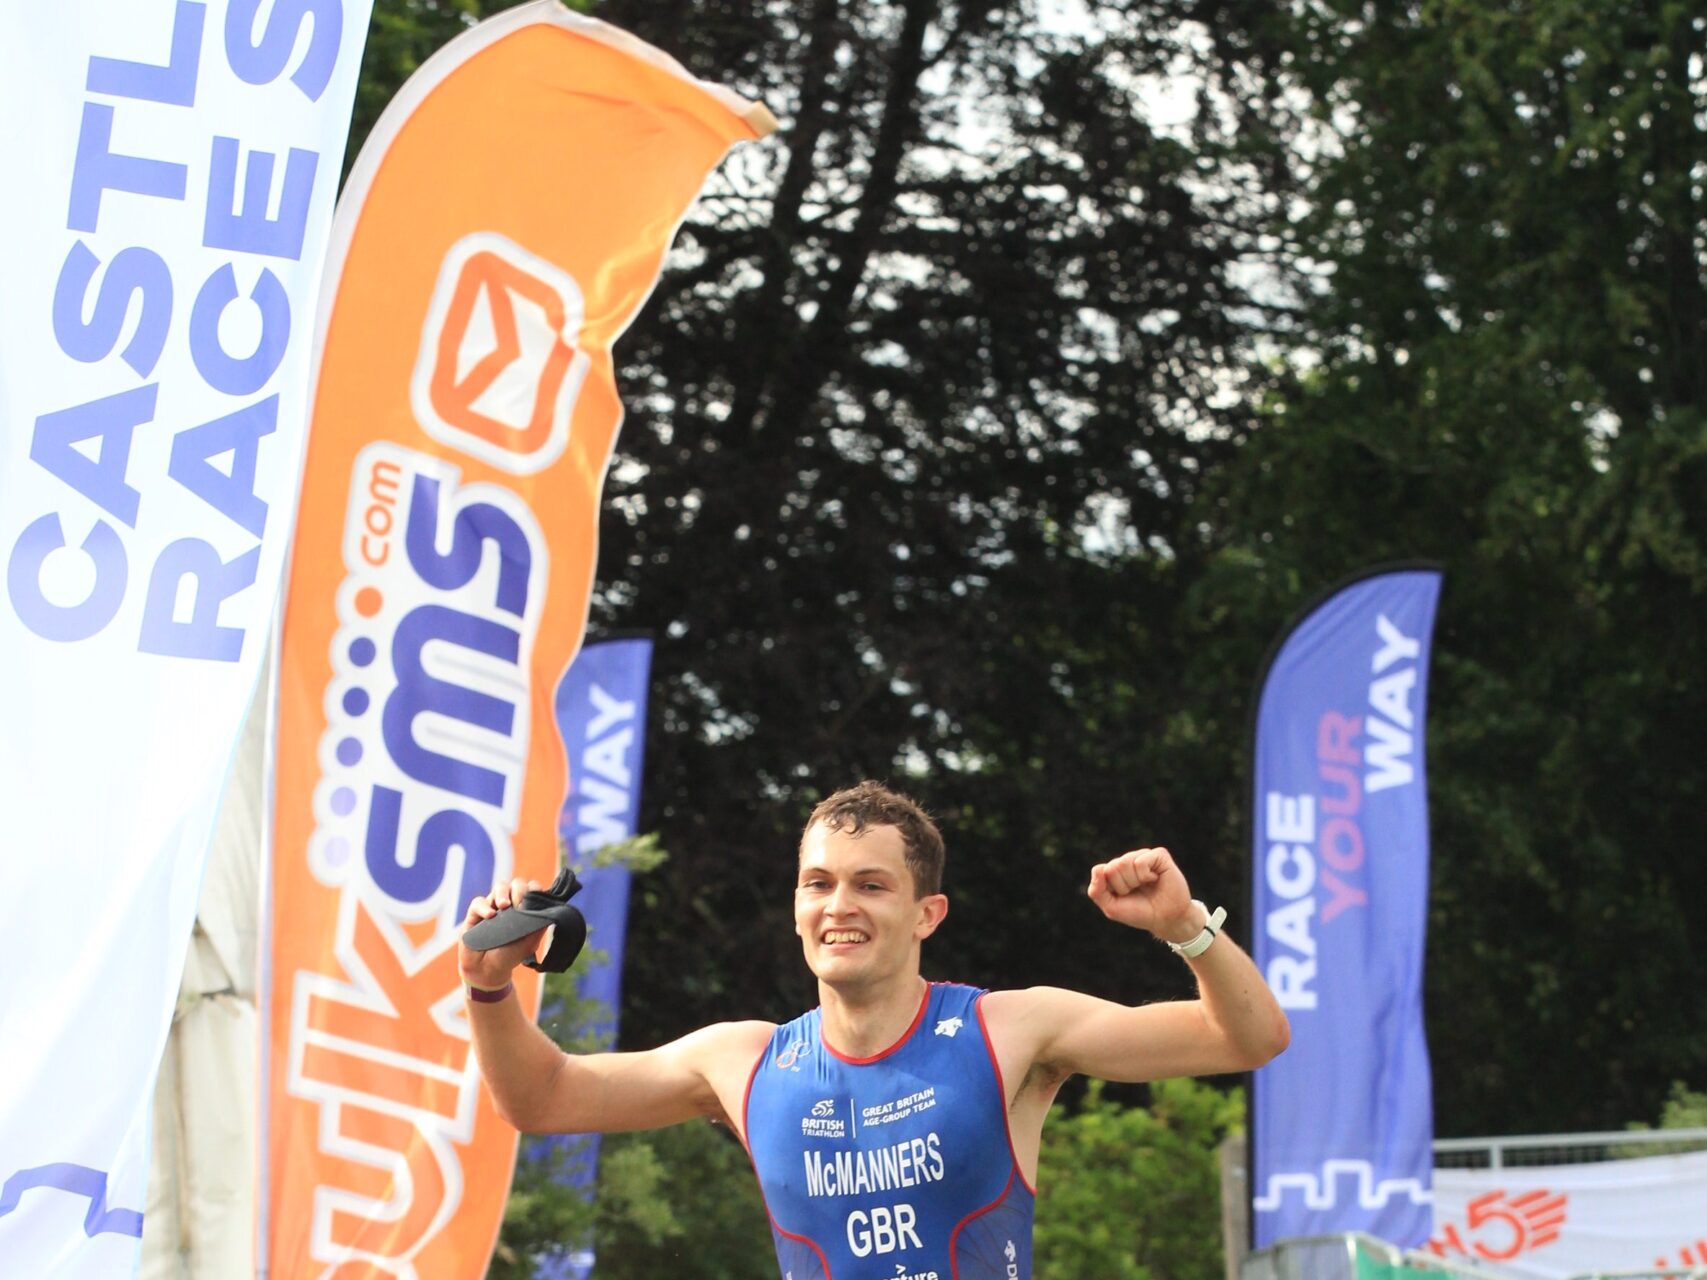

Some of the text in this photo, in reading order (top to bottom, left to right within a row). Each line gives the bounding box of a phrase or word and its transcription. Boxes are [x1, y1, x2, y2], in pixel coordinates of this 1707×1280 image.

[137, 135, 320, 663] RACE
[1365, 613, 1420, 794] WAY
[577, 682, 635, 852] WAY
[1317, 709, 1368, 926] YOUR
[1266, 791, 1317, 1010] RACE
[802, 1117, 845, 1130] BRITISH
[802, 1128, 845, 1138] TRIATHLON
[862, 1087, 935, 1118] GREAT BRITAIN
[863, 1099, 937, 1127] AGE-GROUP TEAM
[804, 1132, 945, 1197] McMANNERS
[846, 1204, 924, 1257] GBR
